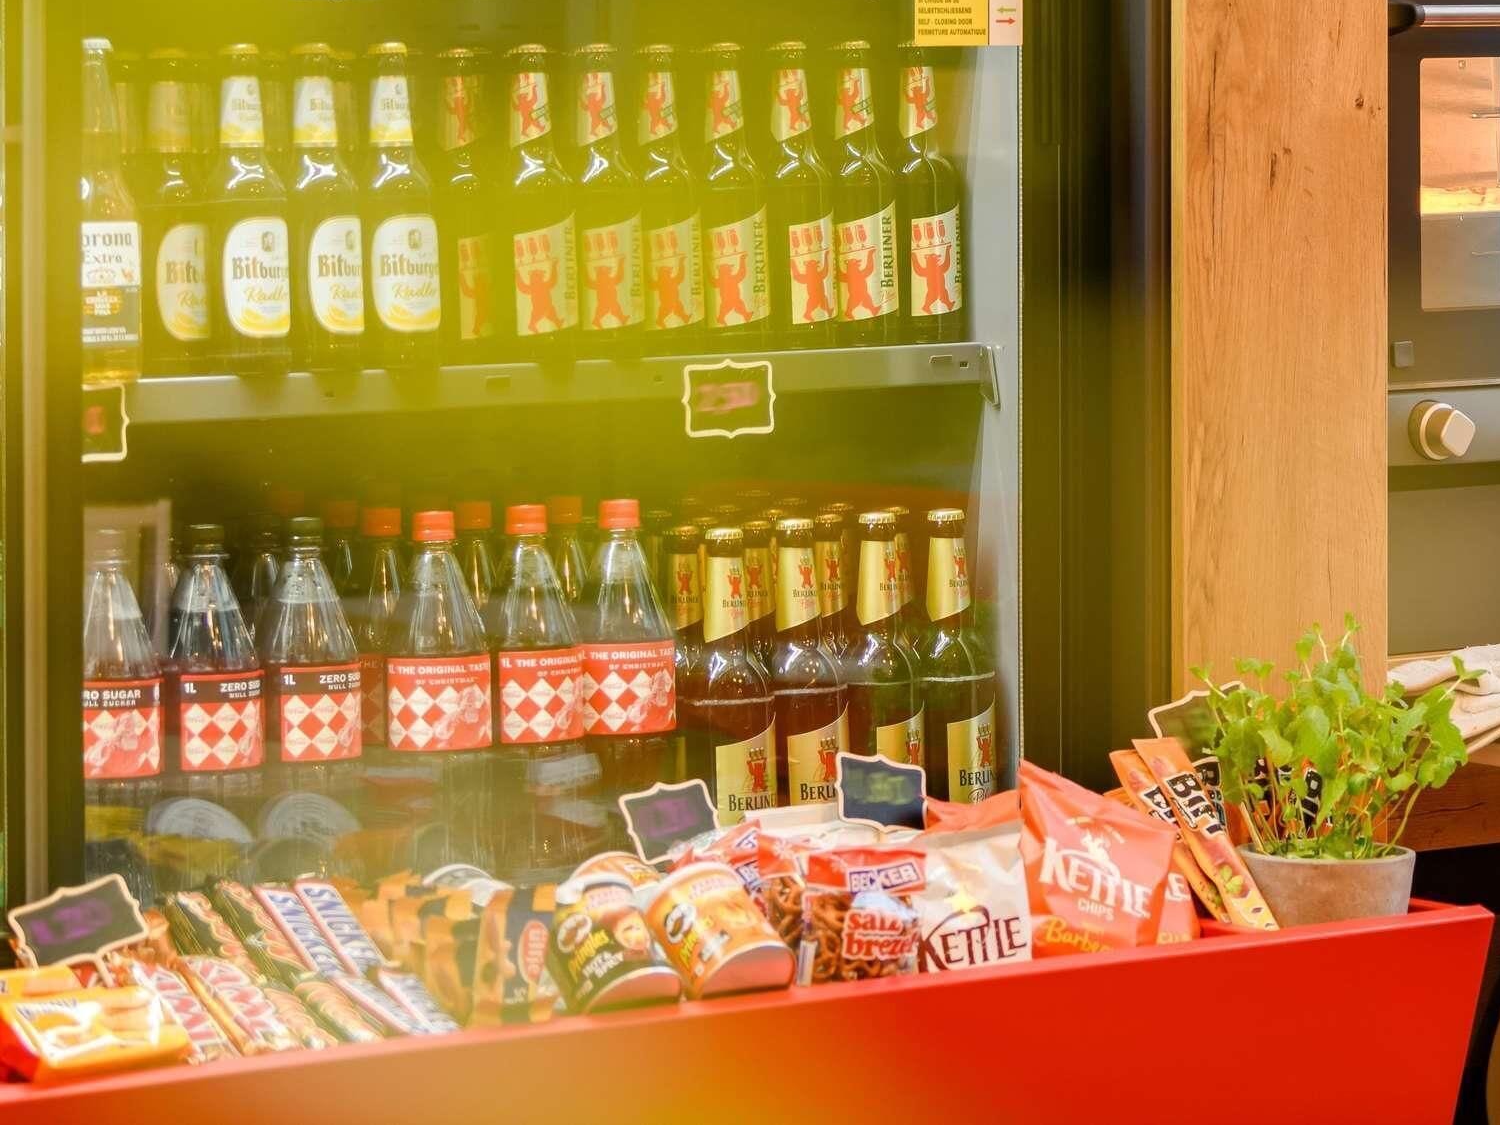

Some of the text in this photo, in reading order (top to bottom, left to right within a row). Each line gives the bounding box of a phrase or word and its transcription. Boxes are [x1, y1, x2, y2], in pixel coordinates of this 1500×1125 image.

[82, 232, 132, 247] orona
[753, 216, 767, 294] BERLINER
[880, 214, 895, 289] BERLINER
[590, 650, 610, 661] THE
[611, 648, 658, 660] ORIGINAL
[397, 665, 415, 676] THE
[417, 663, 467, 676] ORIGINAL
[515, 657, 537, 668] THE
[284, 675, 296, 686] 1L
[319, 674, 346, 684] ZERO
[83, 688, 142, 700] RO SUGAR
[183, 682, 197, 694] 1L
[219, 682, 247, 693] ZERO
[103, 699, 137, 707] ZUCKER
[850, 862, 918, 893] BECKER
[1039, 837, 1152, 918] KETTLE
[1077, 897, 1115, 922] CHIPS
[918, 904, 1027, 974] KETTLE
